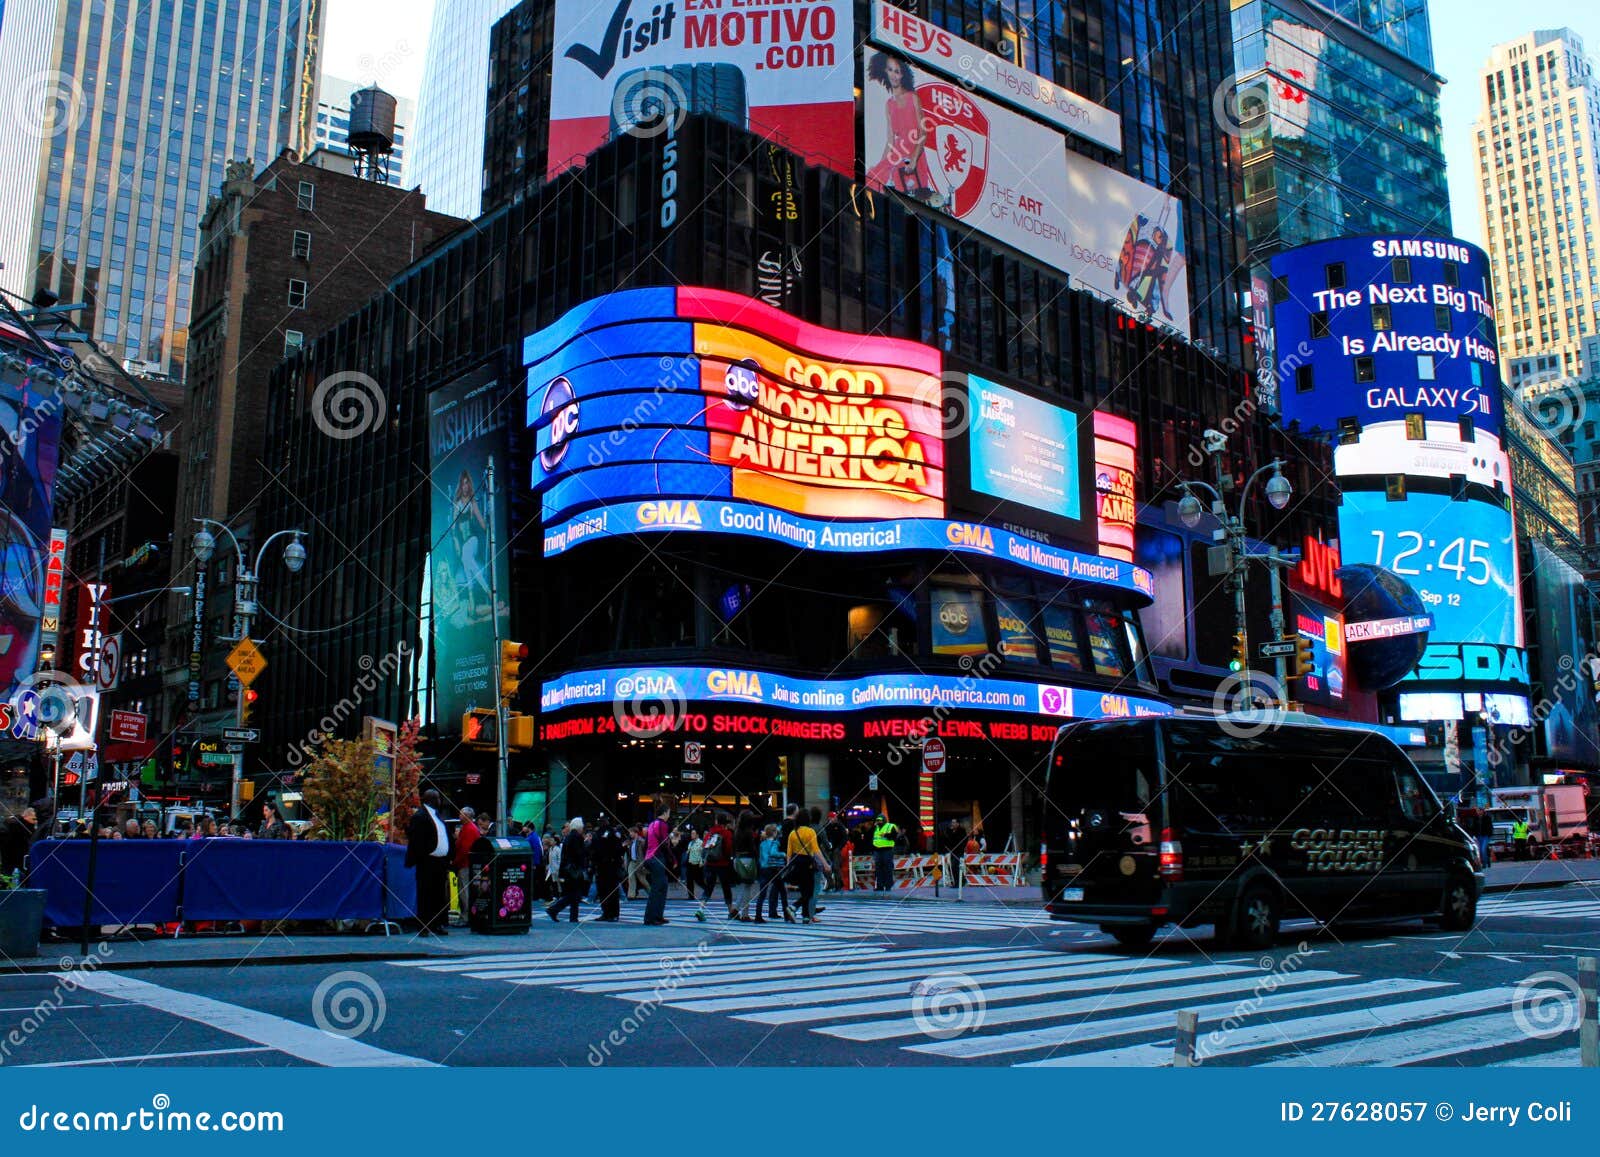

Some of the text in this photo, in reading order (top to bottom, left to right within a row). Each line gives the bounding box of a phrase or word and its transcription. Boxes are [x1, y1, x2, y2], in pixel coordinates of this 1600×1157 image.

[684, 6, 835, 48] MOTIVO
[882, 6, 953, 58] HEYS
[755, 43, 835, 70] .com
[990, 181, 1043, 216] THE ART
[991, 202, 1115, 272] OF MODERN GGAGE
[1372, 239, 1469, 264] SAMSUNG
[1313, 288, 1361, 311] The
[1369, 283, 1427, 304] Next
[1433, 284, 1466, 312] Big
[1342, 332, 1496, 365] Is Already Here
[725, 371, 759, 397] abc
[784, 357, 885, 405] GOOD
[752, 383, 910, 439] MORNING
[1367, 388, 1458, 408] GALAXY
[729, 414, 927, 487] AMERICA
[637, 501, 702, 525] GMA
[720, 506, 764, 531] Good
[821, 525, 901, 547] America!
[566, 512, 607, 544] America!
[946, 522, 995, 549] GMA
[1009, 537, 1119, 581] Good Morning America!
[1301, 535, 1343, 598] JVC
[1371, 530, 1491, 585] 12:45
[45, 540, 64, 605] PARK
[1420, 590, 1461, 606] Sep 12
[939, 602, 968, 625] abc
[1346, 624, 1370, 639] ACK
[1373, 616, 1412, 637] Crystal
[564, 679, 606, 700] America!
[615, 671, 763, 698] @GMA GMA
[772, 684, 788, 701] Join
[803, 689, 844, 706] online
[1013, 694, 1026, 707] on
[1100, 695, 1130, 717] GMA
[597, 716, 615, 733] 24
[619, 714, 676, 733] DOWN
[684, 714, 708, 732] TO
[713, 715, 768, 733] SHOCK
[771, 719, 845, 740] CHARGERS
[990, 722, 1028, 740] WEBB
[199, 742, 217, 751] Deli
[1290, 828, 1386, 849] GOLDEN
[1306, 850, 1385, 871] TOUCH
